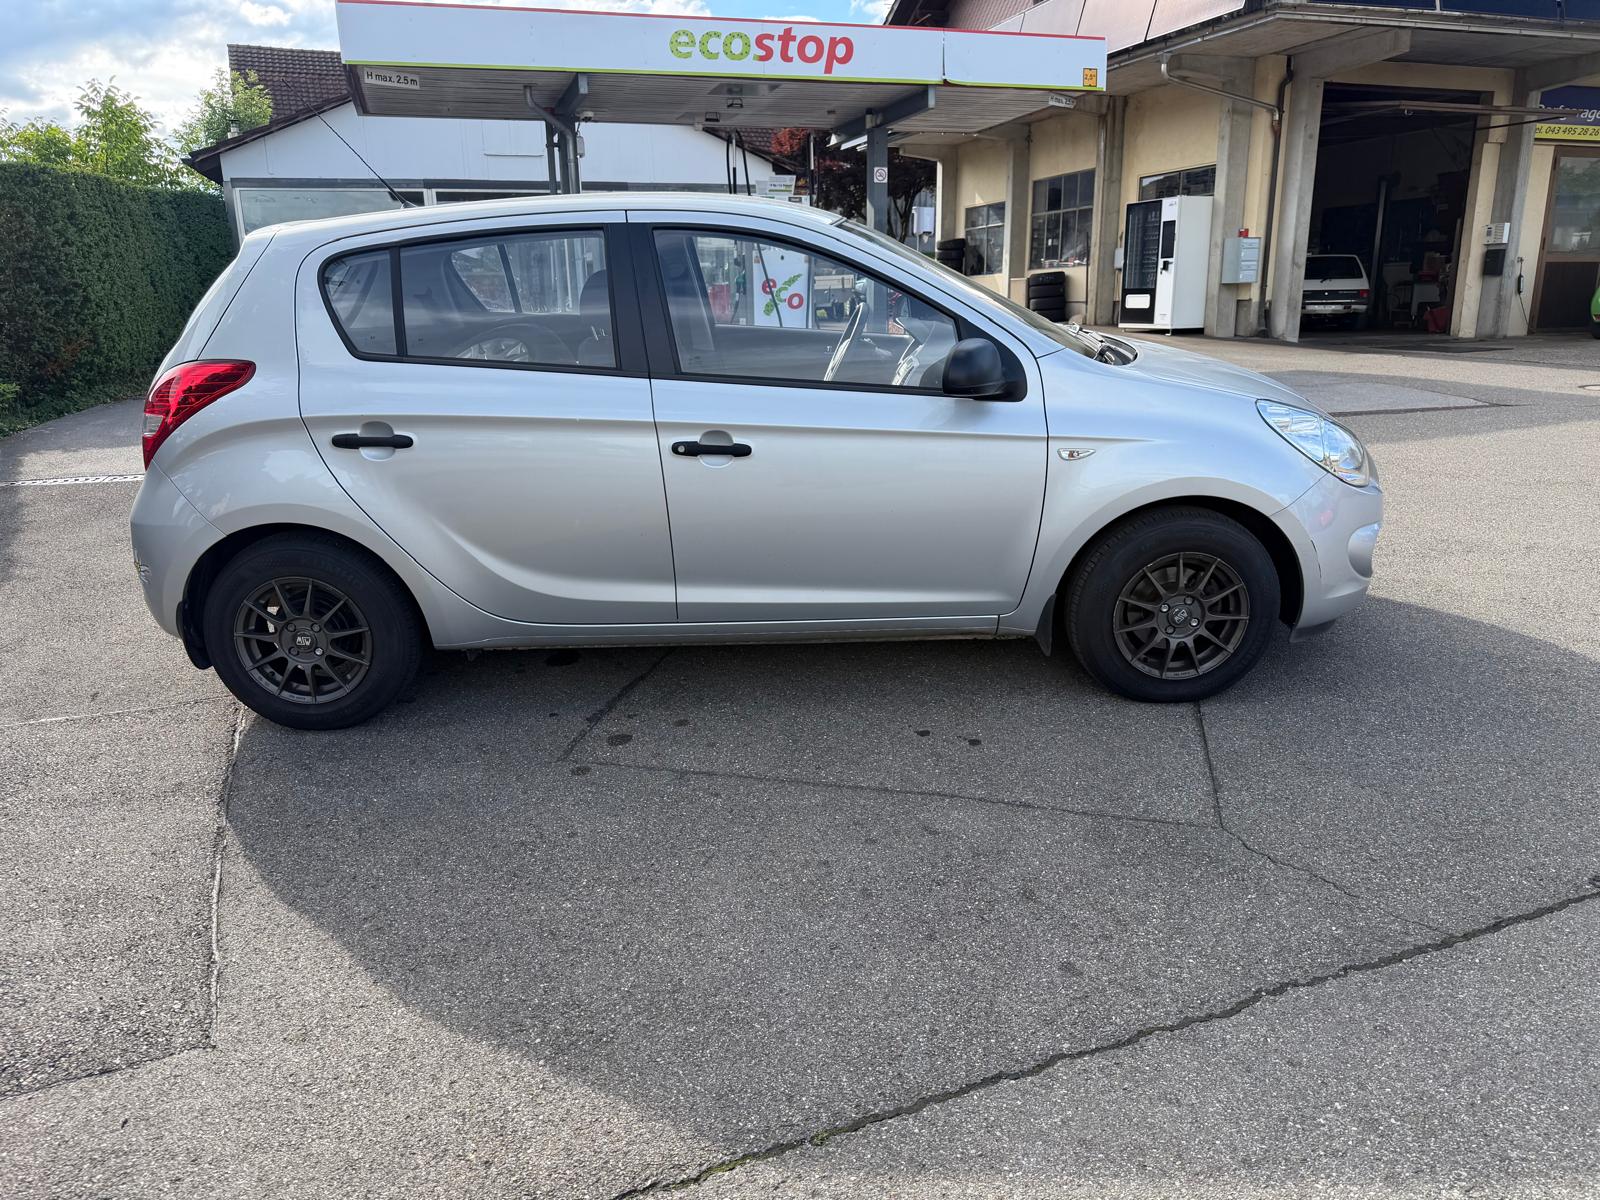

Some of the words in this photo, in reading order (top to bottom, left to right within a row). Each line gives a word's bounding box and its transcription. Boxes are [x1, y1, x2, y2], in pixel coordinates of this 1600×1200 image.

[669, 27, 855, 75] ecostop
[366, 71, 373, 80] H
[375, 73, 396, 84] max.
[396, 75, 409, 85] 2.5
[410, 78, 418, 87] m
[1544, 126, 1561, 135] 043
[1562, 127, 1577, 136] 495
[1577, 127, 1589, 136] 28
[1589, 128, 1600, 137] 26
